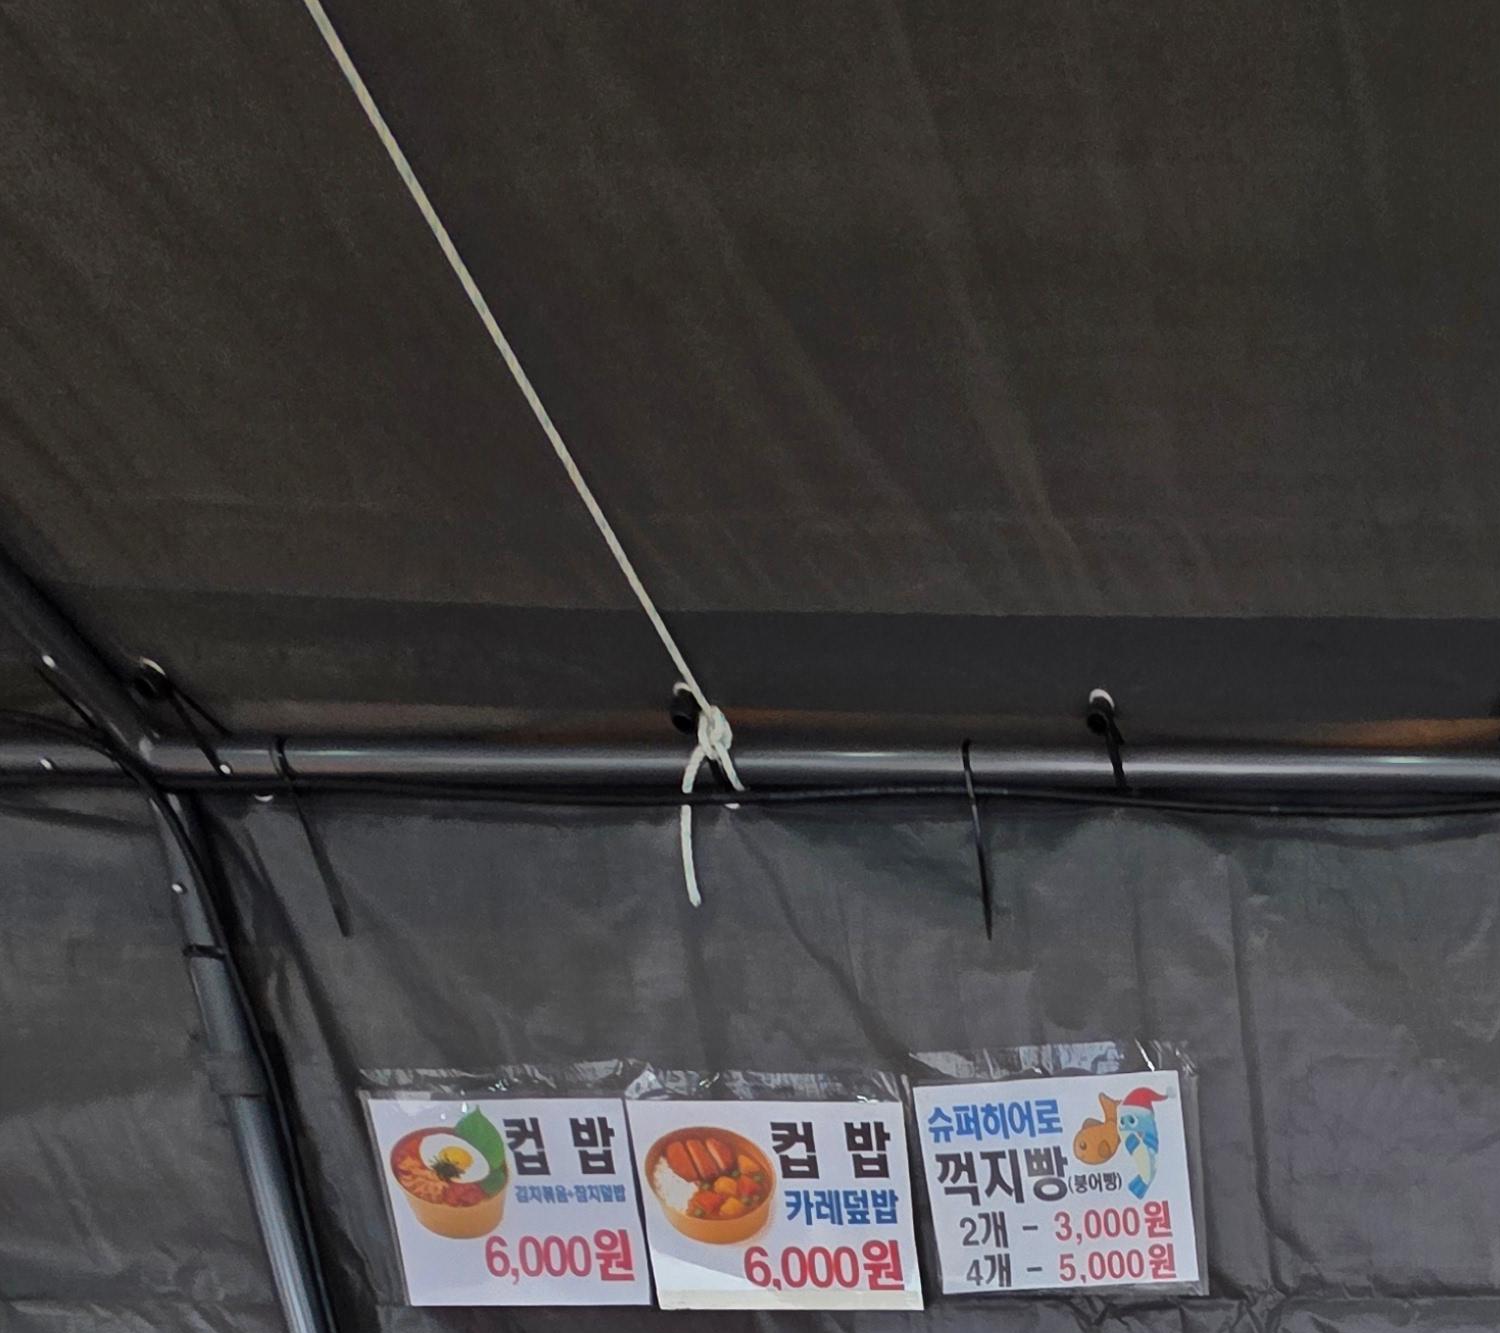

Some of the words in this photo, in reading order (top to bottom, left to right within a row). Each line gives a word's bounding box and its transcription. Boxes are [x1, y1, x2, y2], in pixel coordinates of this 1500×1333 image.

[928, 1099, 1063, 1143] 슈퍼히어로
[784, 1189, 899, 1225] 카레덮밥
[960, 1211, 1009, 1248] 2개
[1054, 1200, 1173, 1245] 3,000원
[485, 1229, 635, 1285] 6,000원
[744, 1240, 905, 1291] 6,000원
[966, 1253, 1012, 1287] 4개
[1059, 1243, 1177, 1283] 5,000원
